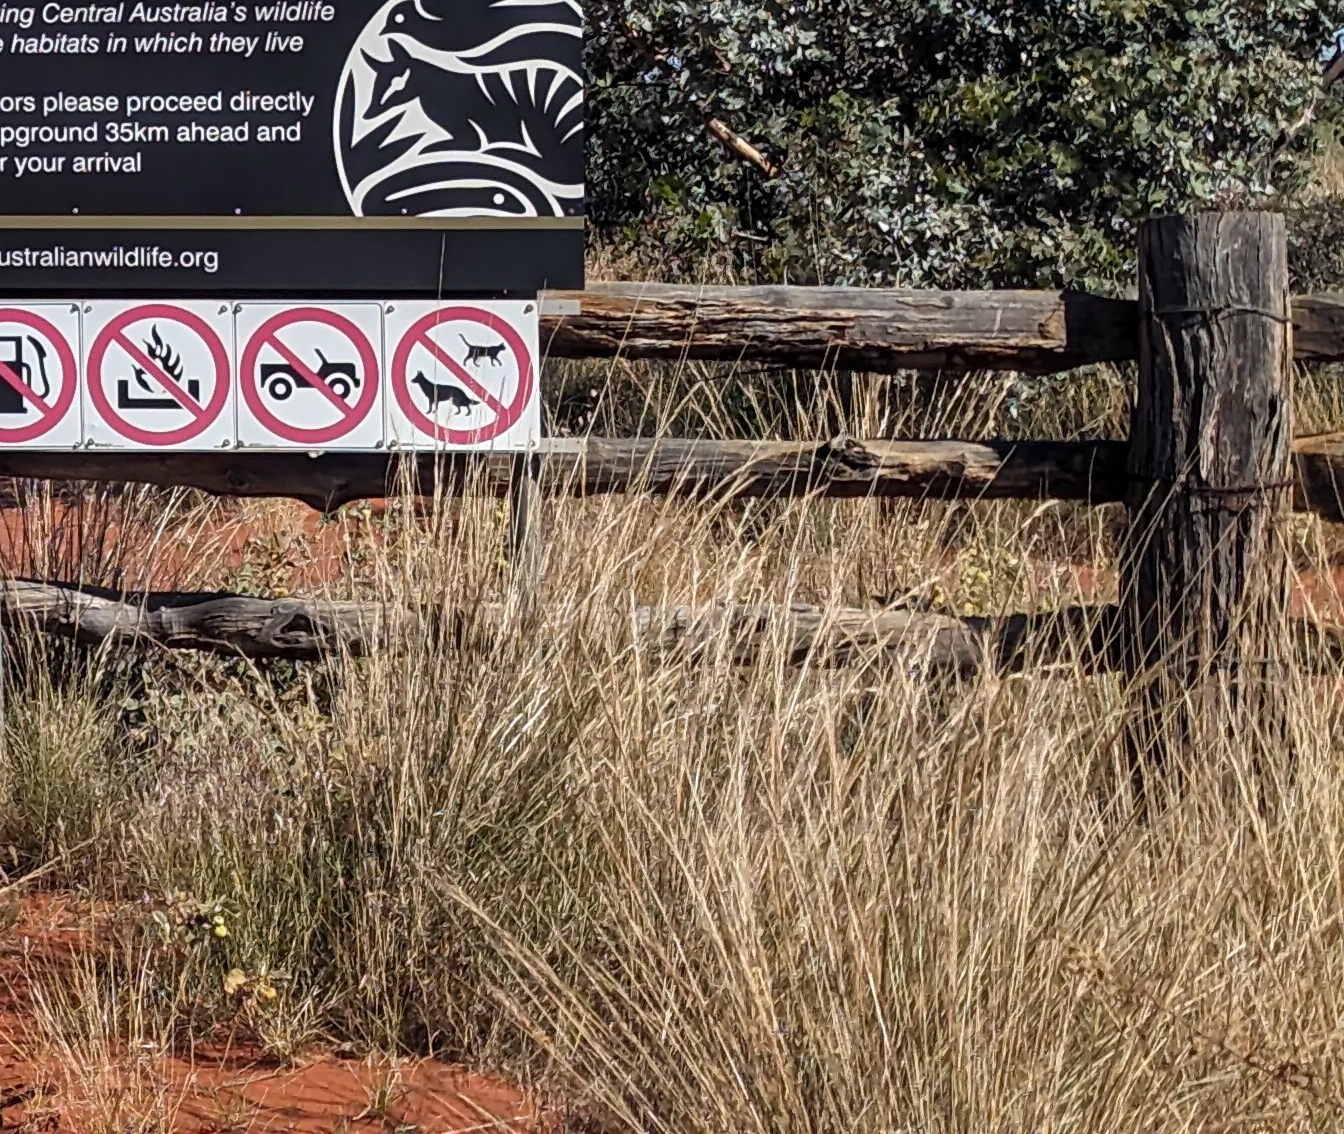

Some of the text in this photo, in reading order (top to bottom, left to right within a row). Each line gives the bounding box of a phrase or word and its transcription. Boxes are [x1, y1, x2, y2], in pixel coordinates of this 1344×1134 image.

[42, 2, 125, 24] Central
[128, 1, 248, 23] Australia's
[254, 0, 335, 22] wildlife
[10, 32, 100, 54] habitats
[106, 32, 128, 53] in
[133, 31, 203, 53] which
[209, 31, 260, 58] they
[264, 31, 304, 52] live
[43, 91, 119, 117] please
[126, 90, 223, 117] proceed
[229, 90, 315, 117] directly
[104, 121, 169, 143] 35km
[176, 121, 249, 142] ahead
[256, 120, 301, 142] and
[13, 156, 66, 178] your
[72, 151, 142, 173] arrival
